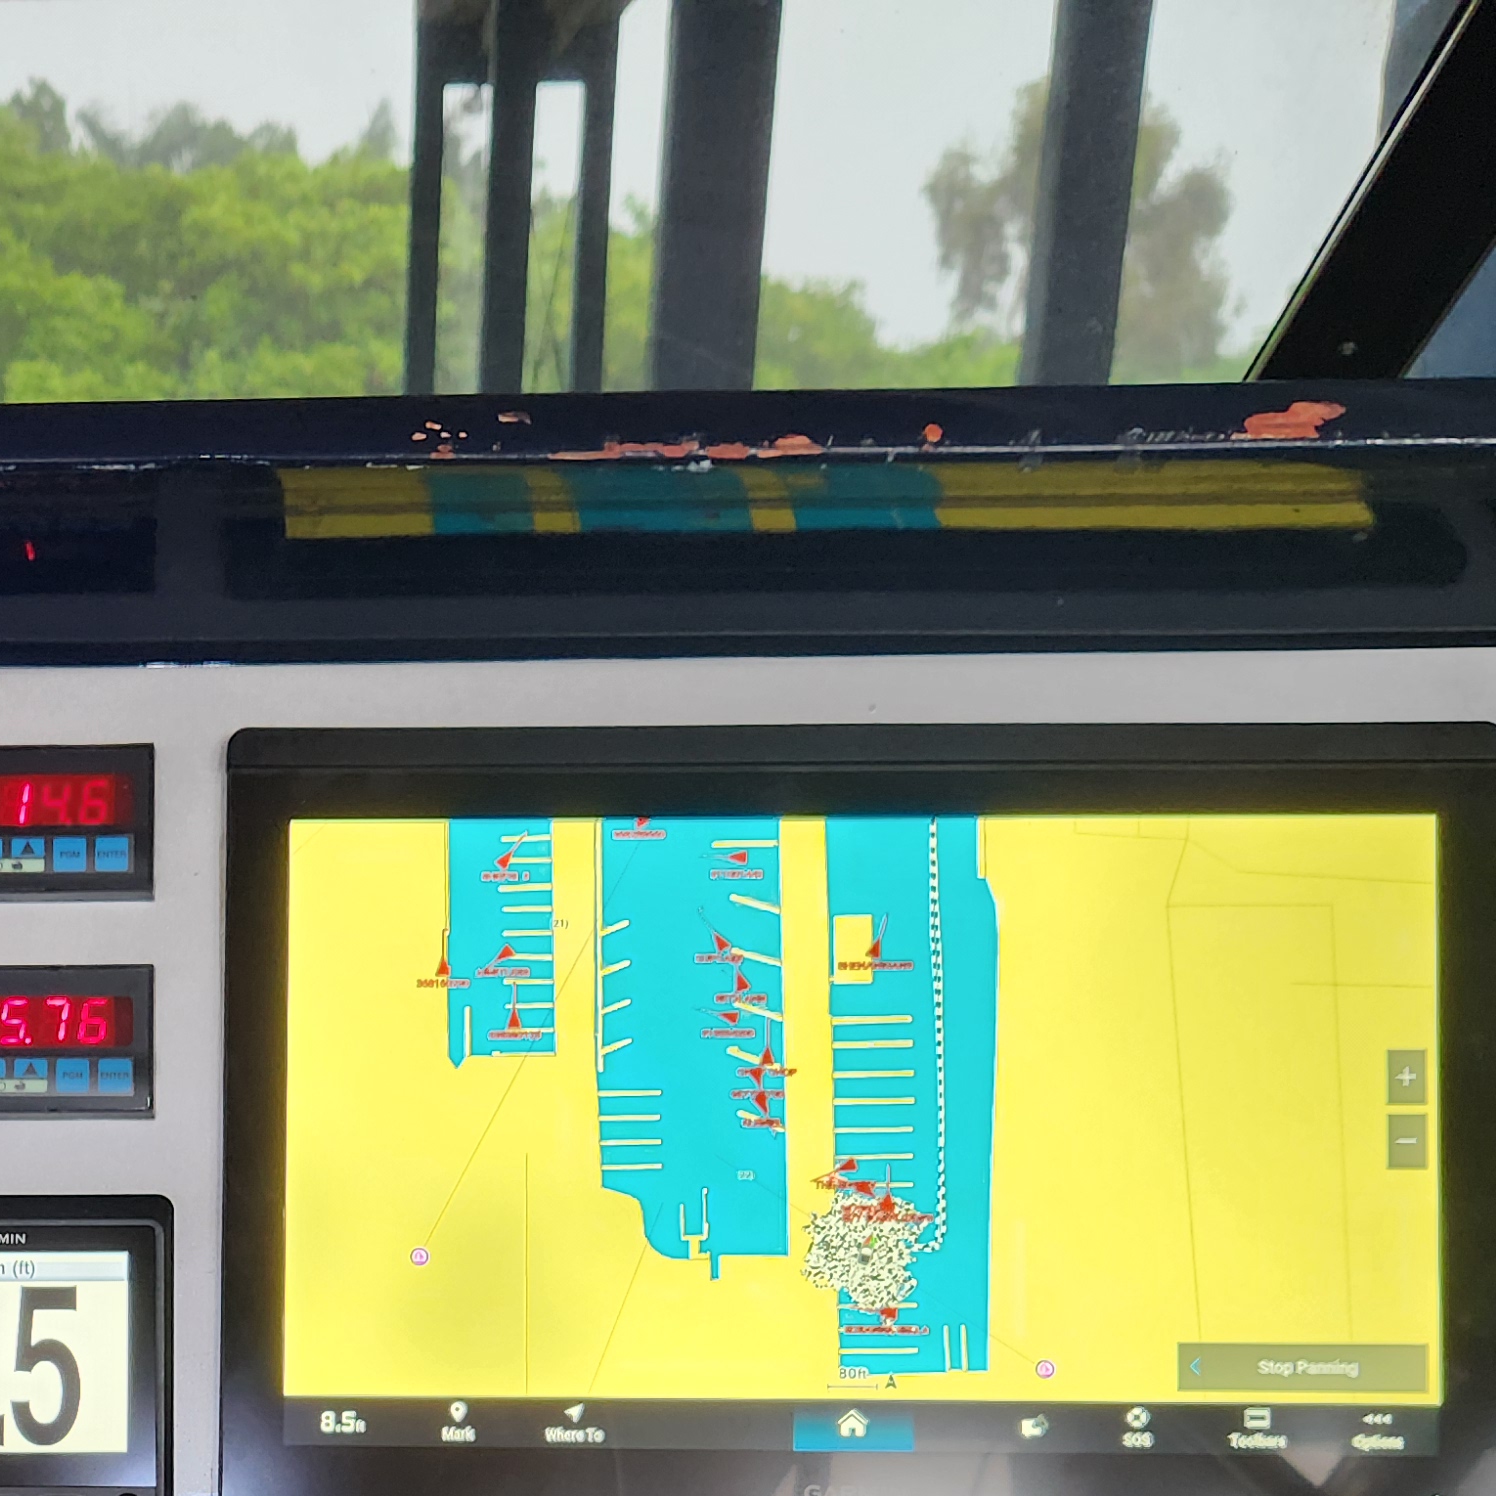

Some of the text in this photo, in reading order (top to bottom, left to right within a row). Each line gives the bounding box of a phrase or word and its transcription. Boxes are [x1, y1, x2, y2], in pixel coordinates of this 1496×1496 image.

[12, 1260, 36, 1279] (ft)
[1257, 1359, 1360, 1379] Stop Panning
[441, 1426, 476, 1443] Mark
[586, 1426, 605, 1443] To
[1123, 1432, 1154, 1449] SOS
